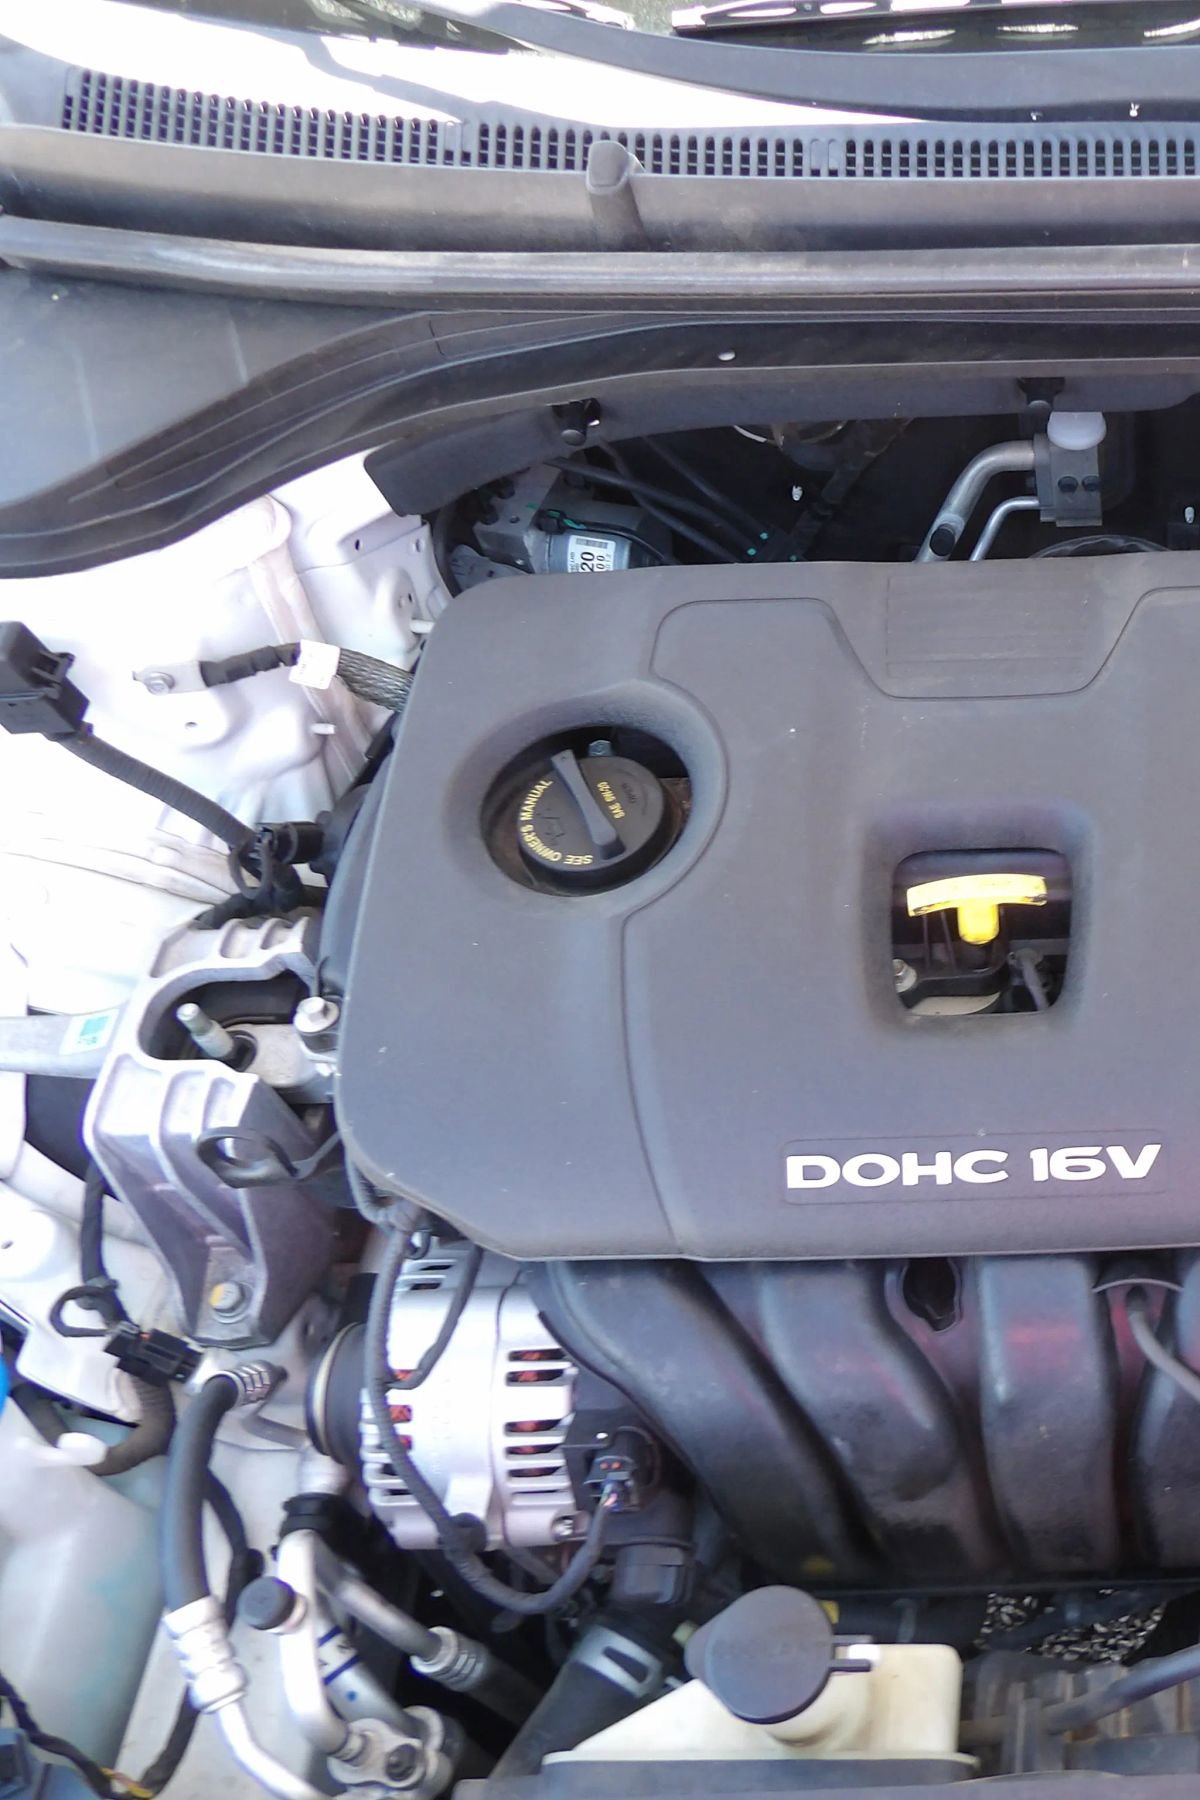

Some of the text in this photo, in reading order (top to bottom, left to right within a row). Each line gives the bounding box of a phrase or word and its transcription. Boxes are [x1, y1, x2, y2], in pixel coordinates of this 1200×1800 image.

[520, 780, 594, 865] SEE OWNER'S MANUAL
[608, 802, 625, 819] SAE
[786, 1144, 1162, 1189] DOHC 16V
